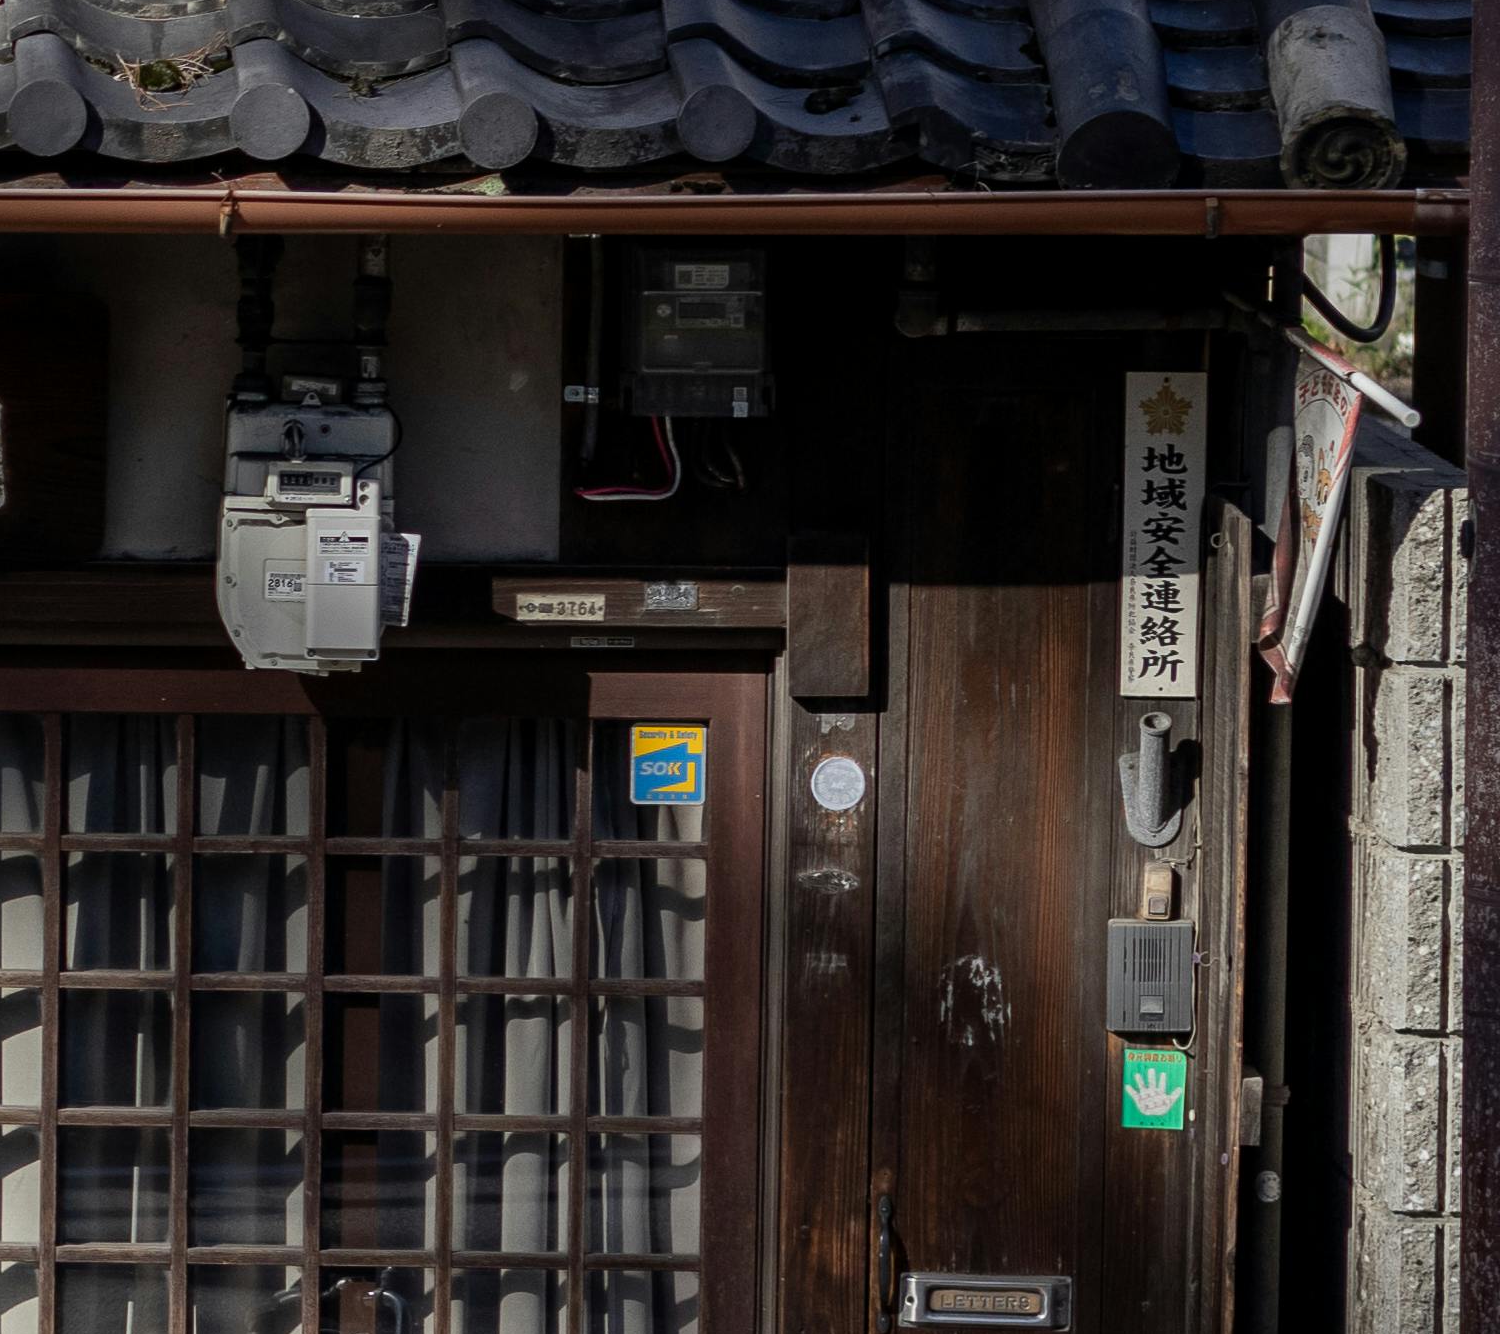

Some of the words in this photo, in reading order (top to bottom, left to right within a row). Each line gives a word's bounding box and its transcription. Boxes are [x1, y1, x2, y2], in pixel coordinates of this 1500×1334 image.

[1138, 443, 1188, 683] 地域安全連絡所
[556, 601, 597, 616] 3764
[639, 761, 682, 776] SOK
[940, 1293, 1031, 1311] LETTERS
